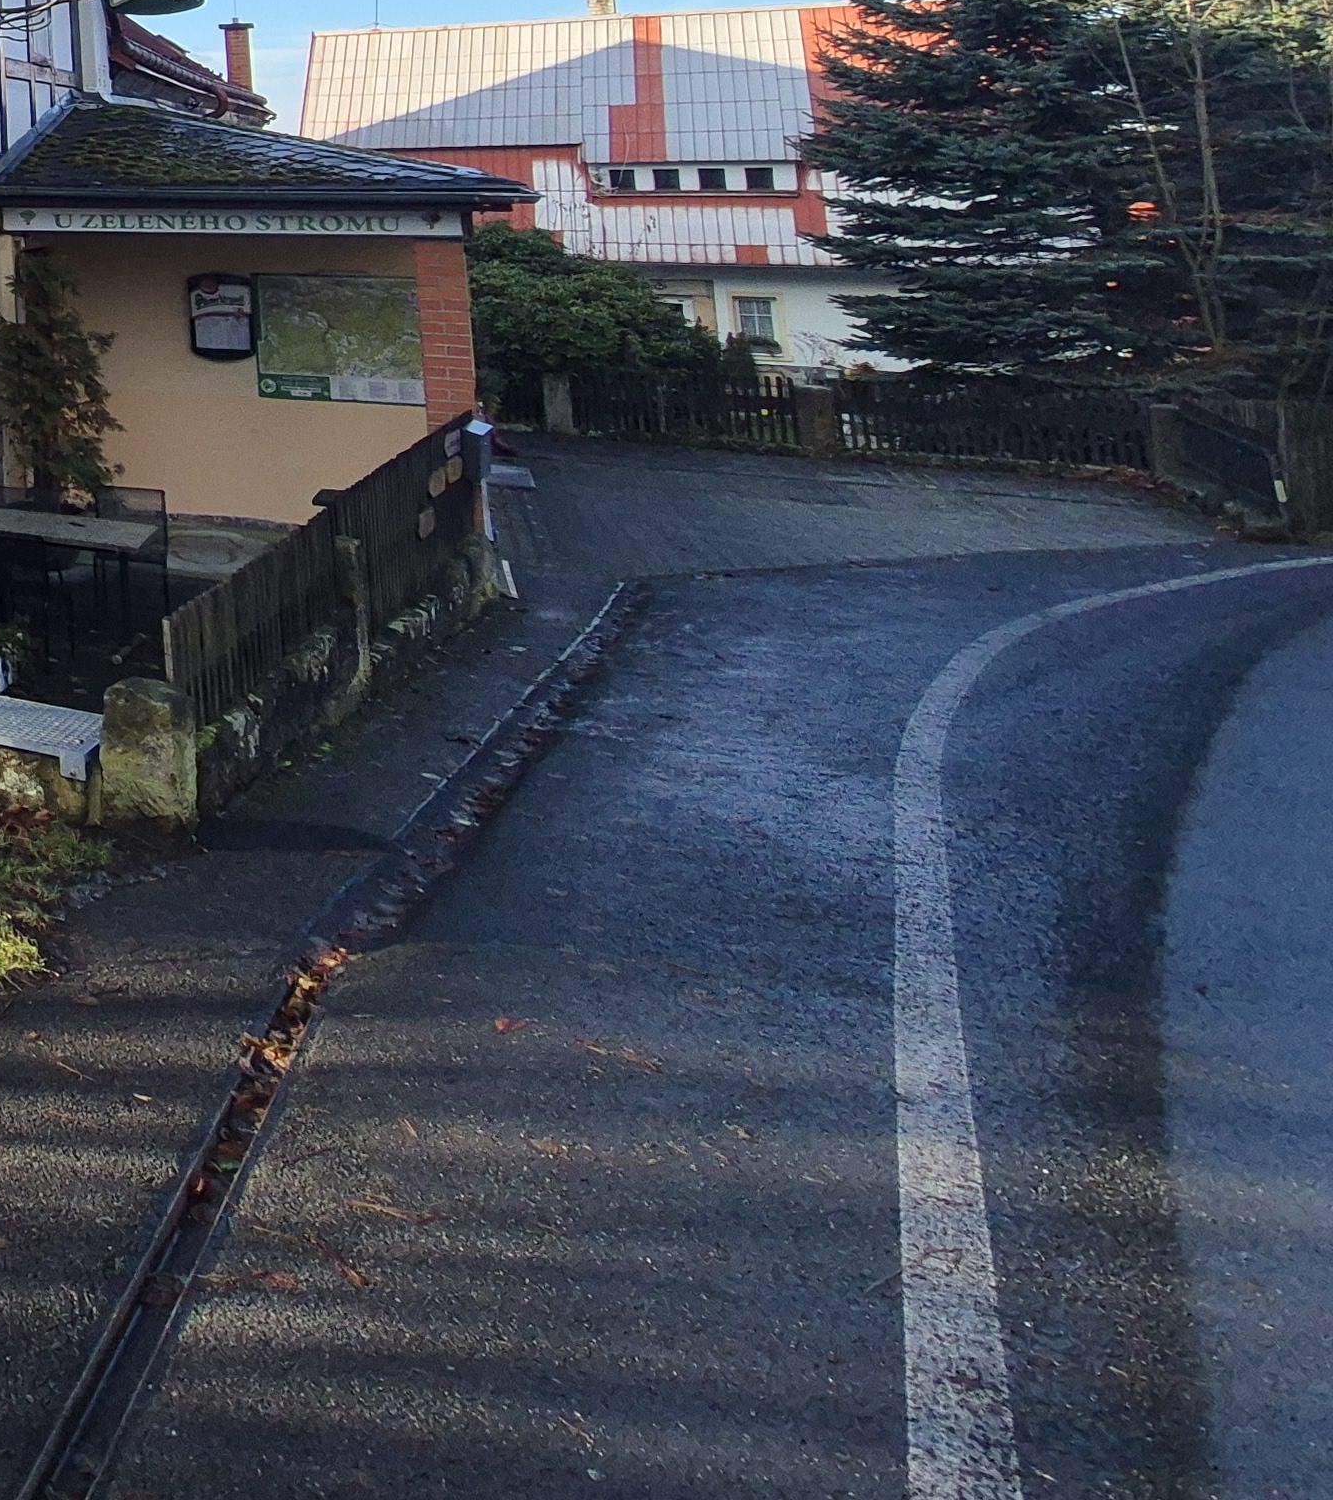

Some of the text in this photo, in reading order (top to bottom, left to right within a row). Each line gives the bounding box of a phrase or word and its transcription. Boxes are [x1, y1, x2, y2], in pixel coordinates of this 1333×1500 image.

[53, 210, 402, 233] U ZELENÉHO STROMU
